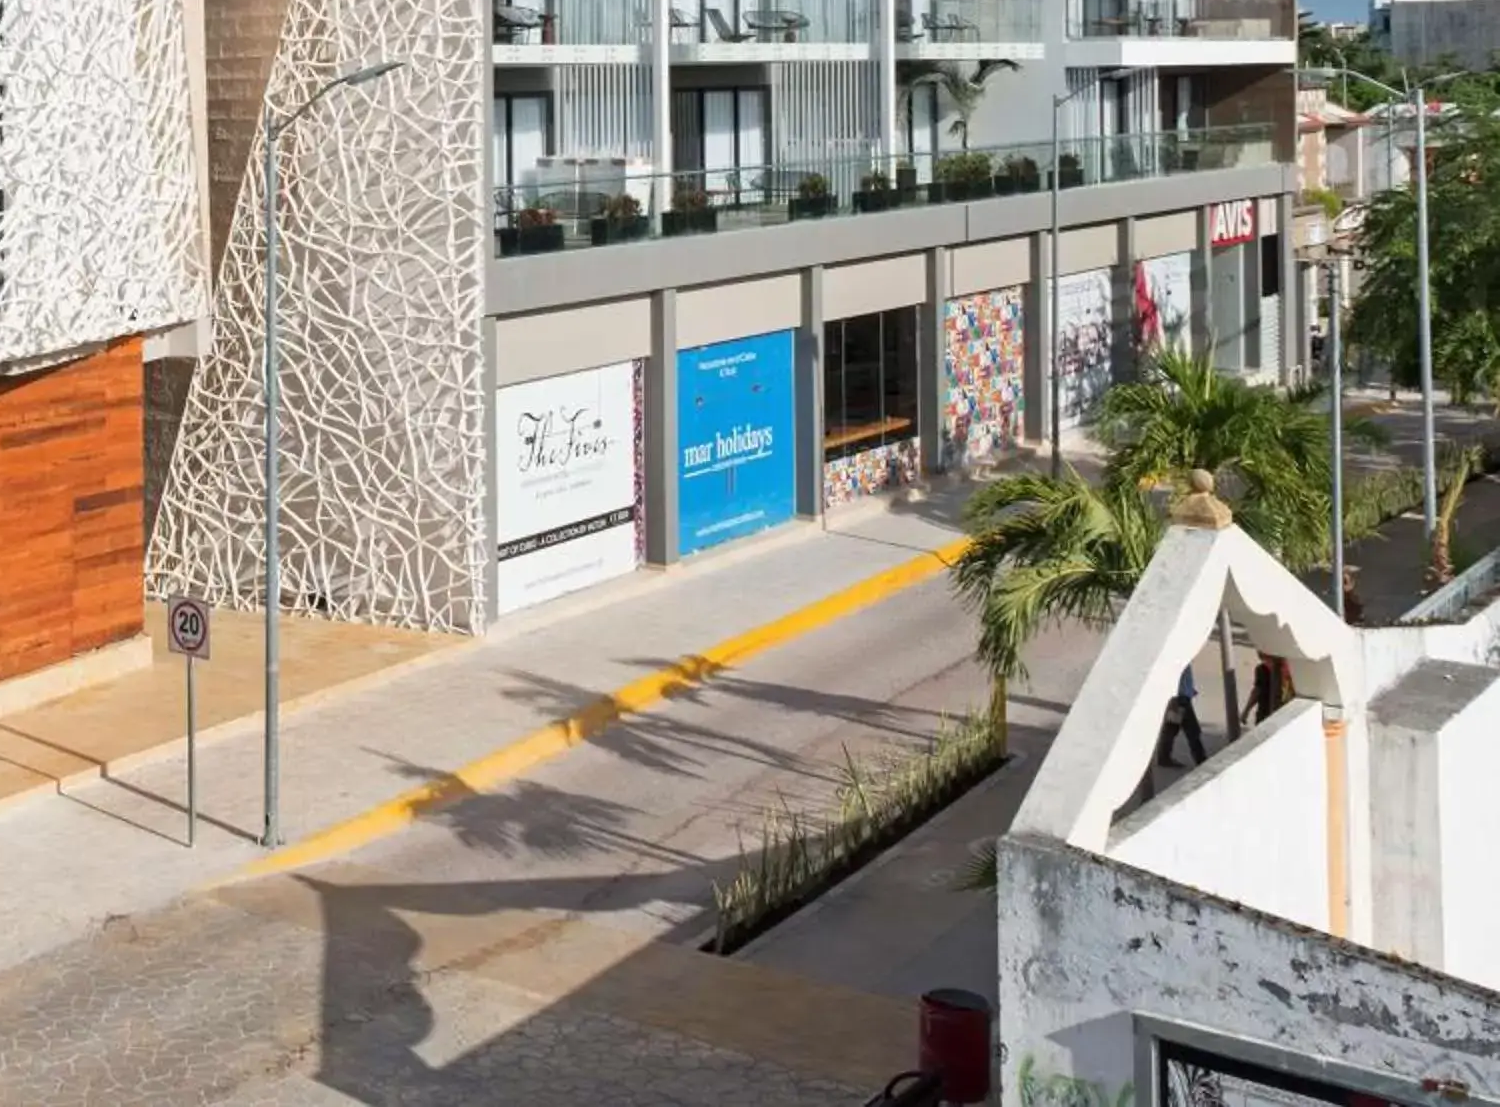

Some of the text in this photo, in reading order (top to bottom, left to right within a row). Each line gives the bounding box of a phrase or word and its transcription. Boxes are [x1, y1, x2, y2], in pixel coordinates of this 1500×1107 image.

[1213, 199, 1252, 242] AVIS
[684, 442, 714, 468] mar
[715, 422, 773, 459] holidays
[179, 610, 199, 635] 20
